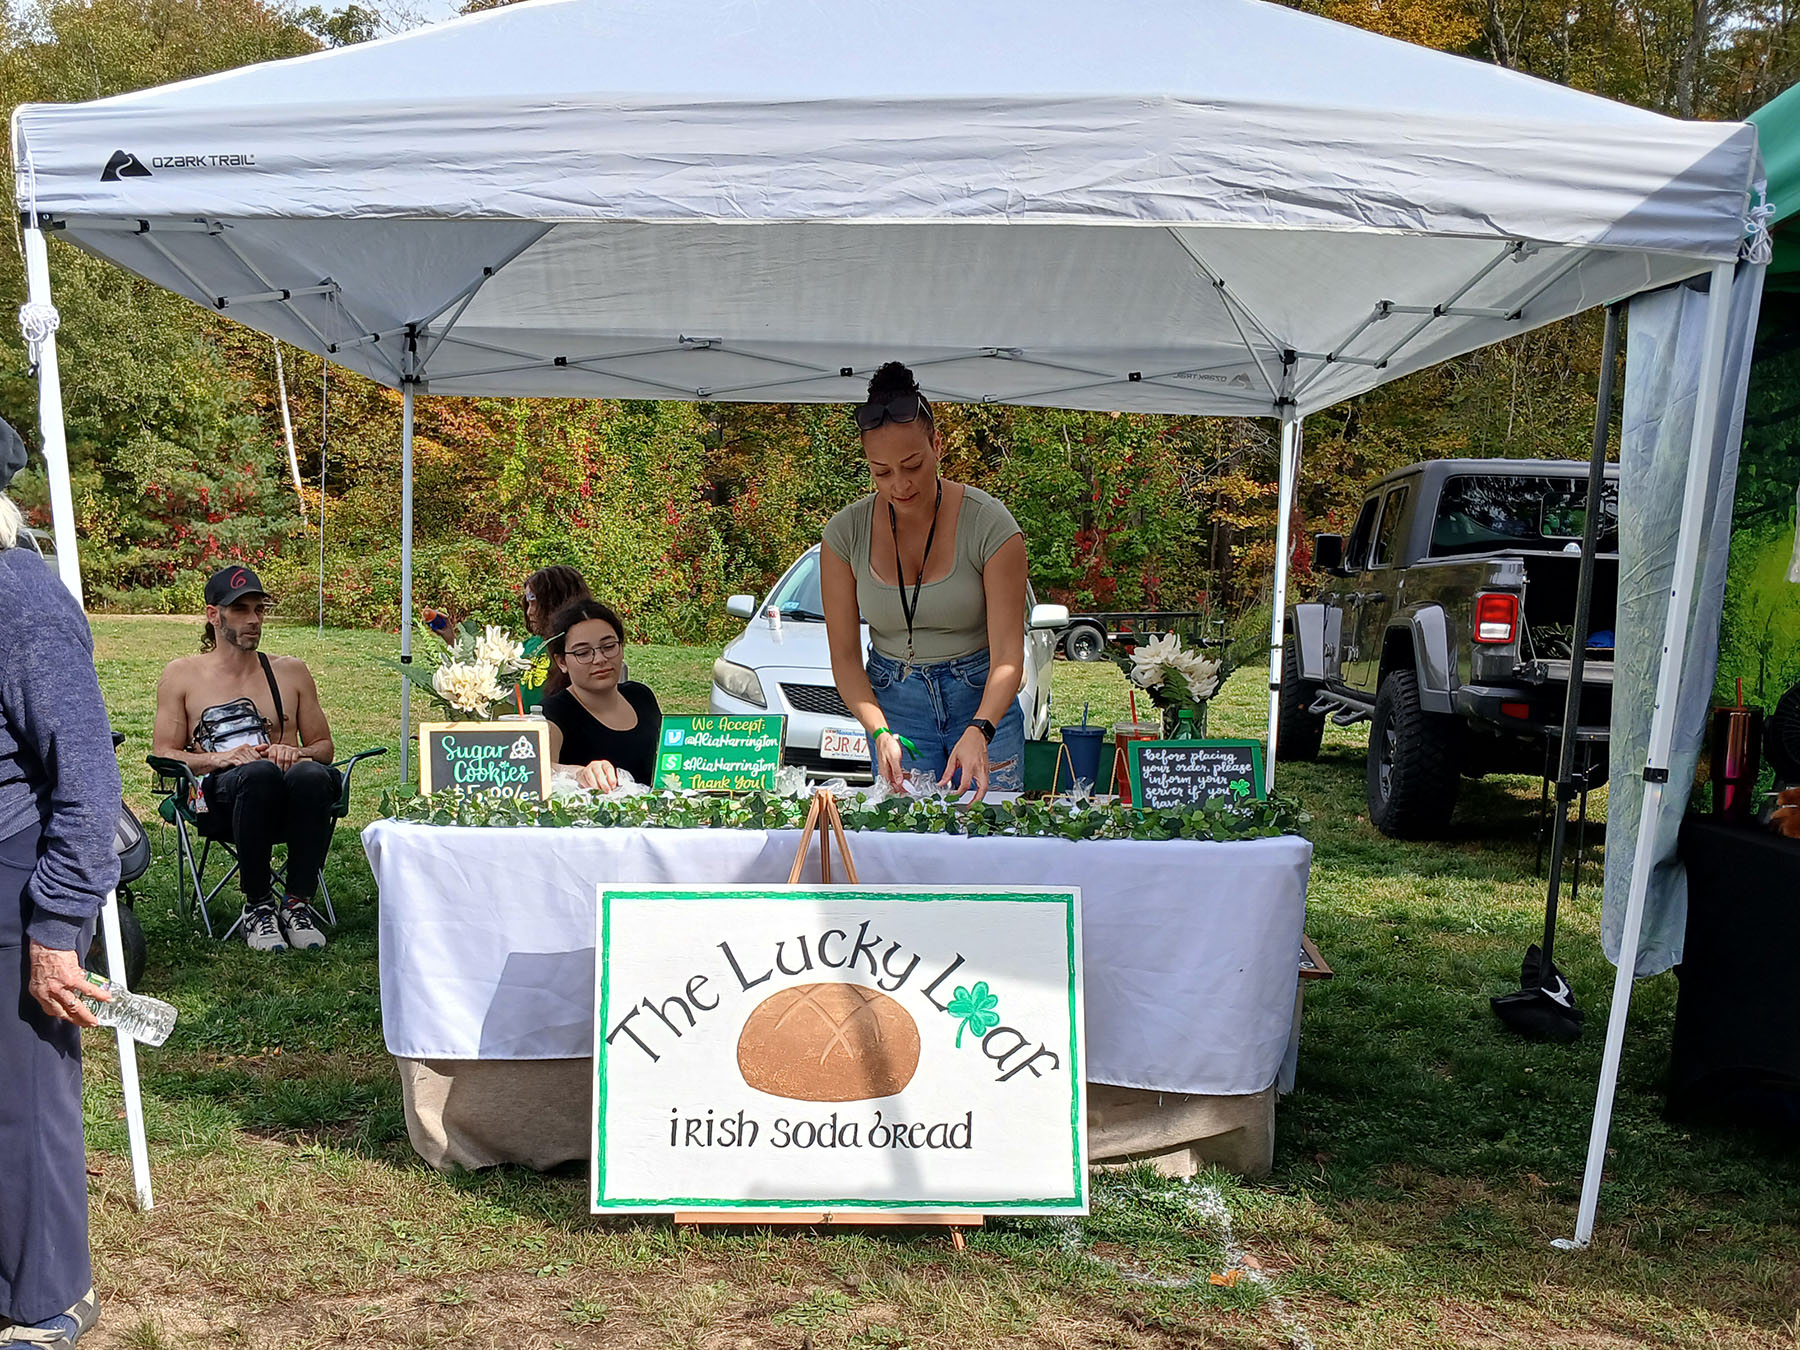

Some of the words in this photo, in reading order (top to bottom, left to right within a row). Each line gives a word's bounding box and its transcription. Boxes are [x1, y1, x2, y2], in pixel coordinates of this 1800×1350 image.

[152, 155, 207, 168] OZARK
[691, 716, 714, 731] We
[719, 716, 765, 736] Accept:
[684, 732, 778, 752] @AliaHarrington
[824, 736, 849, 752] 2JR
[441, 735, 509, 770] Sugar
[1143, 749, 1186, 764] before
[1190, 750, 1237, 763] placing
[453, 760, 534, 787] Cookies
[683, 757, 776, 777] $AliaHarrington
[1142, 764, 1170, 778] your
[1213, 763, 1252, 776] please
[688, 774, 731, 789] Thank
[734, 774, 766, 789] You!
[1148, 774, 1191, 788] inform
[1197, 775, 1228, 789] your
[1145, 786, 1183, 799] server
[1187, 785, 1201, 800] if
[1207, 787, 1231, 799] you
[605, 974, 720, 1063] The
[716, 919, 921, 992] Lucky
[770, 1112, 858, 1148] soda
